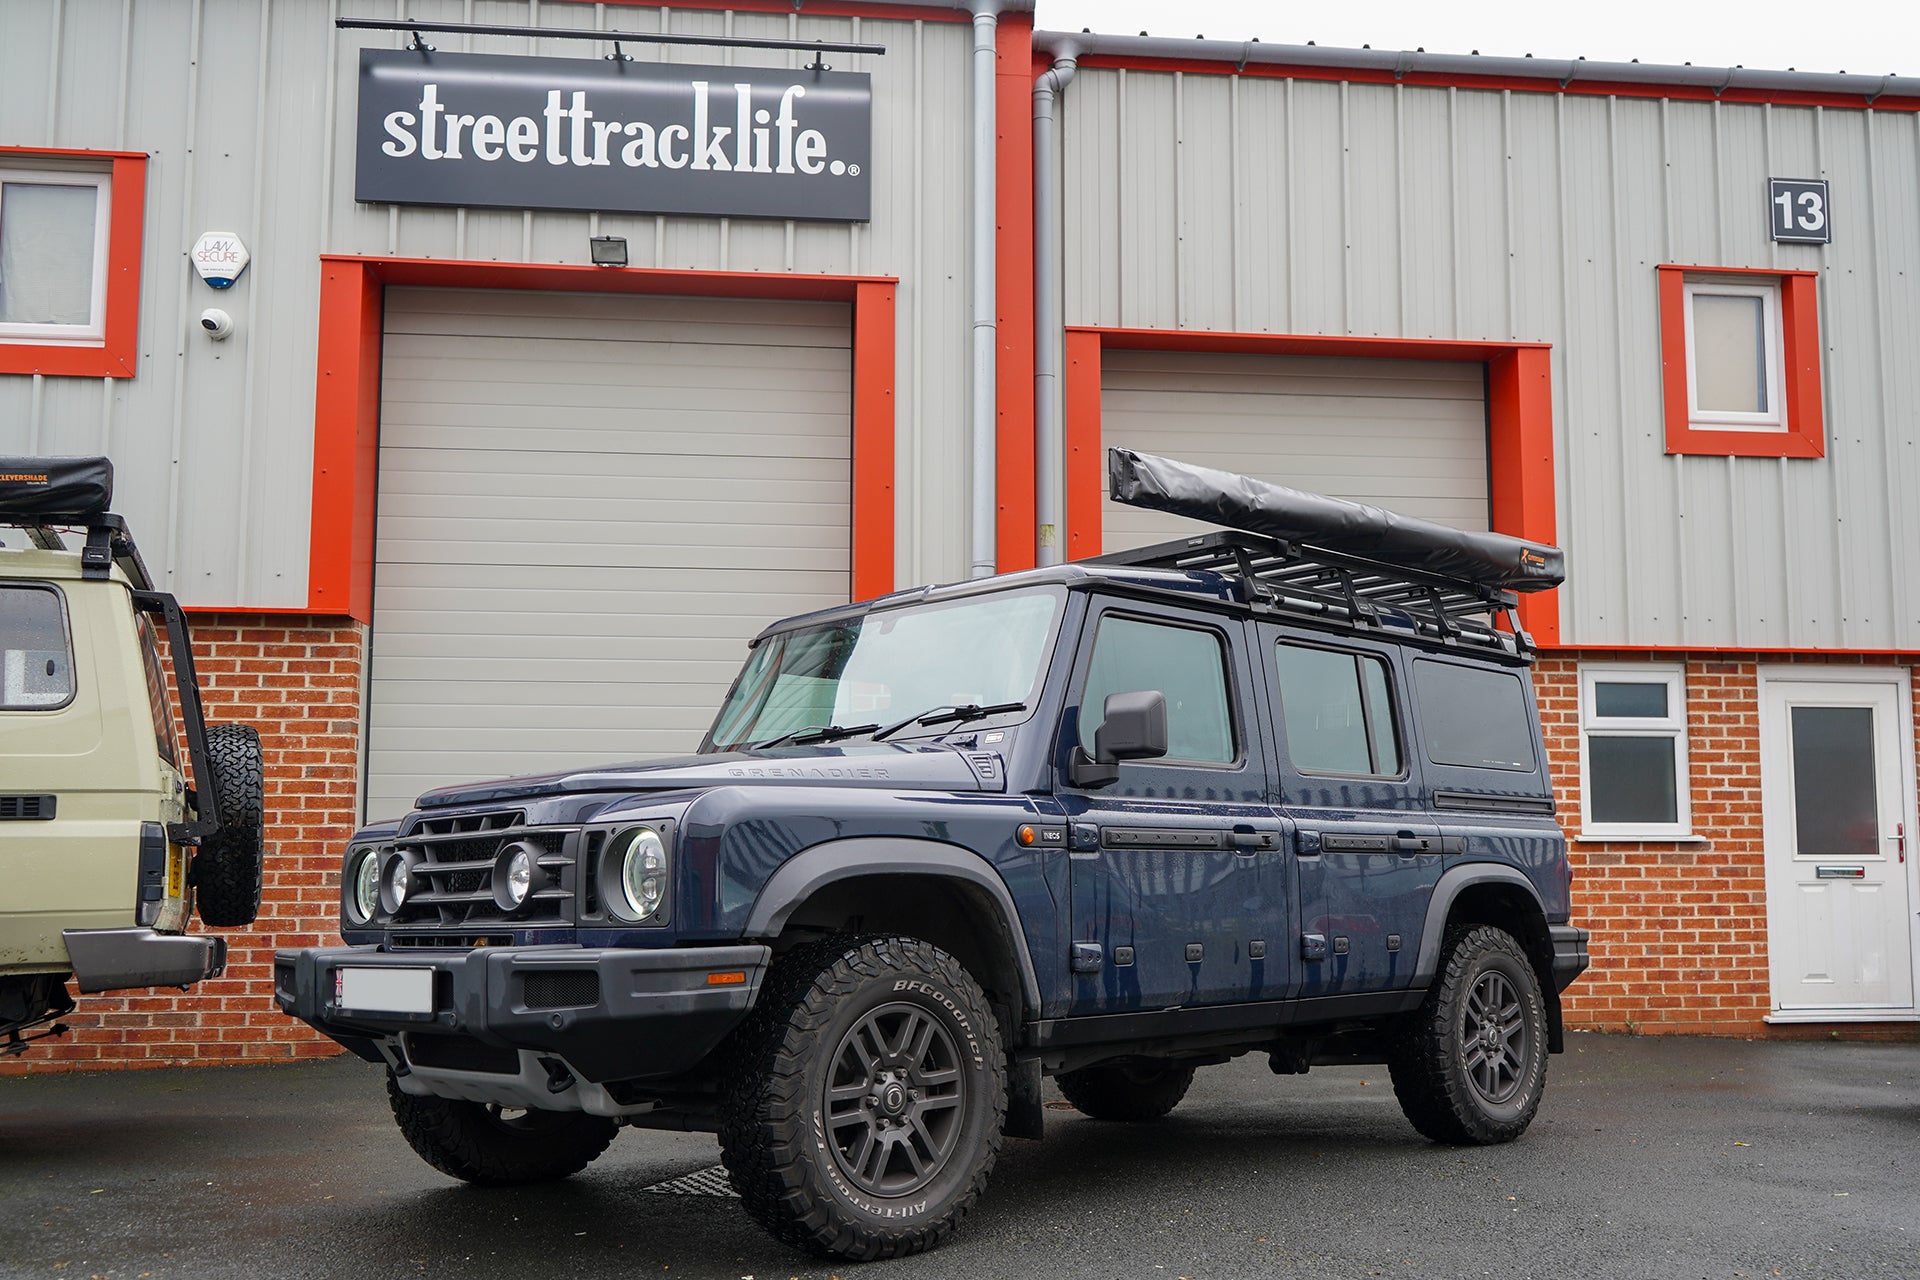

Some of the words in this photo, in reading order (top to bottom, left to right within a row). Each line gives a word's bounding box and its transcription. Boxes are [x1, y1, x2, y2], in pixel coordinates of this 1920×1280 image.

[1774, 191, 1825, 231] 13
[204, 240, 234, 251] LAW
[197, 251, 239, 262] SECURE
[728, 768, 890, 778] GRENADIER
[1043, 832, 1060, 840] INEOS
[893, 980, 984, 1071] BFGoodrich
[826, 1164, 927, 1219] All-Terrain
